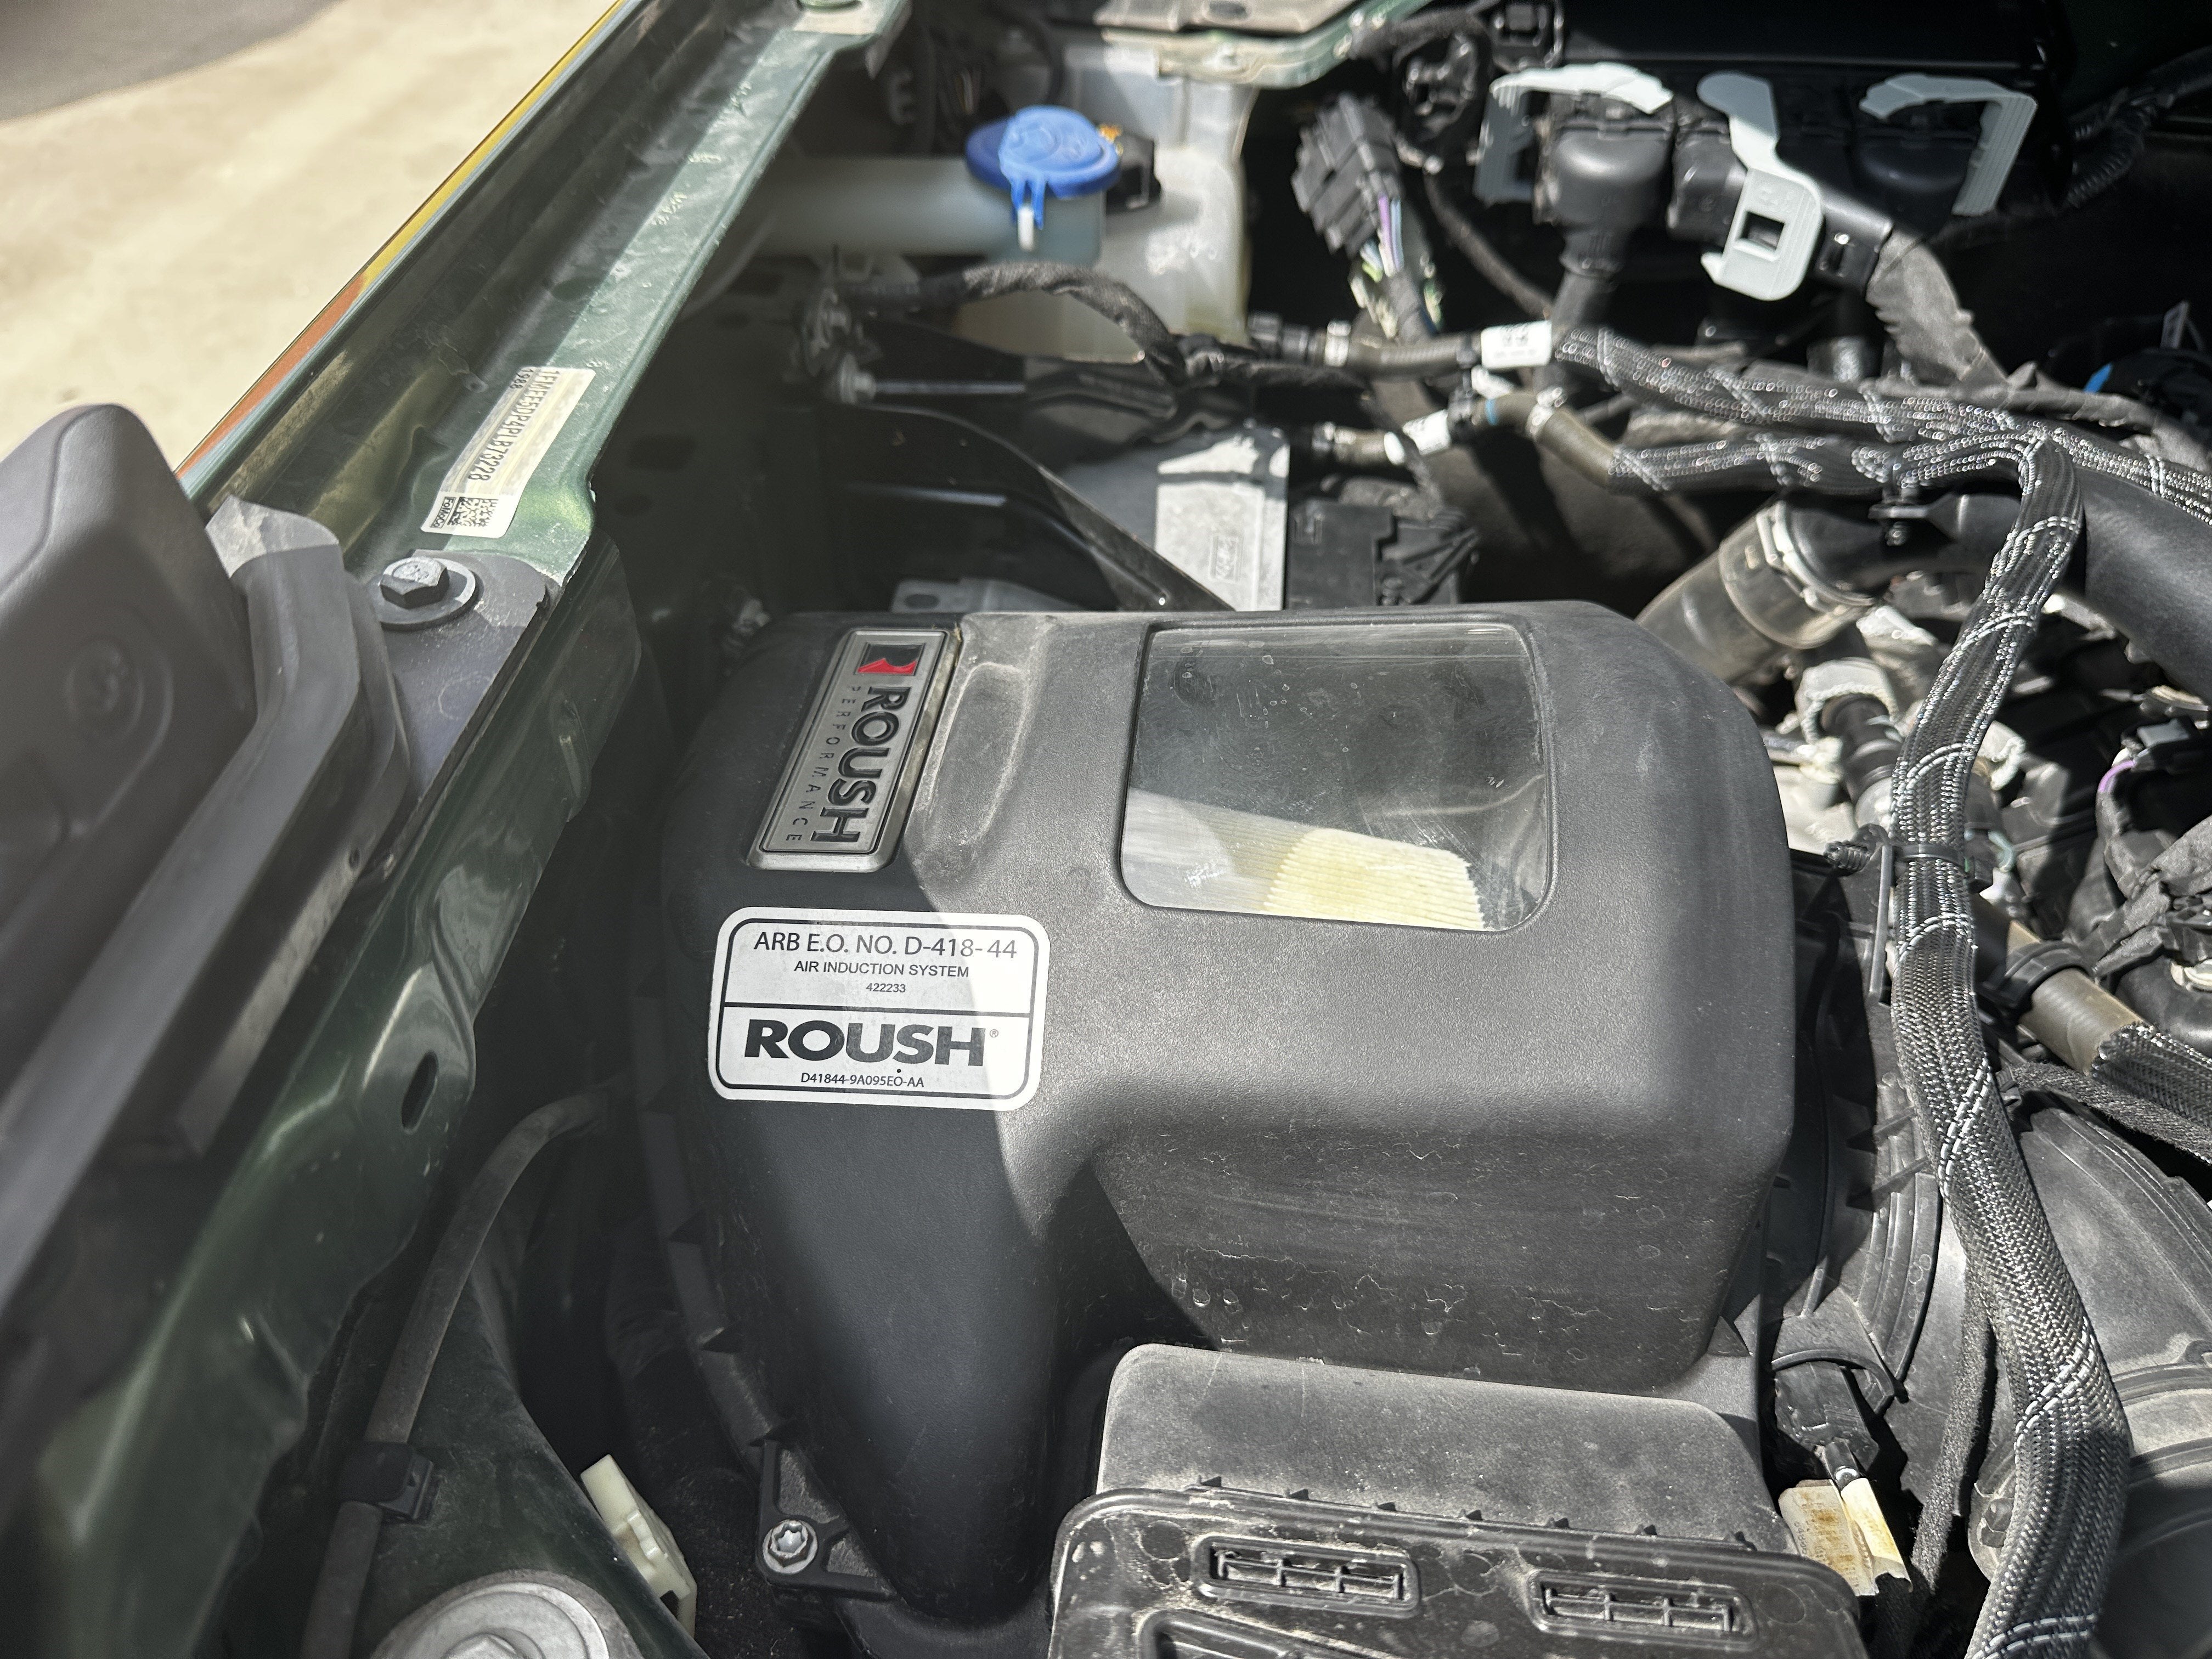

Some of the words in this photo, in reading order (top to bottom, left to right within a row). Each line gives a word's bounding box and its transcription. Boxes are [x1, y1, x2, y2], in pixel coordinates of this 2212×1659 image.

[433, 497, 454, 527] FoMoCo
[786, 685, 861, 842] PERFORMANCE
[810, 686, 911, 843] ROUSH
[753, 932, 800, 951] ARB
[807, 933, 849, 953] E.O.
[856, 935, 897, 955] NO.
[794, 961, 819, 973] AIR
[823, 961, 905, 975] INDUCTION
[908, 964, 969, 978] SYSTEM
[866, 983, 906, 993] 422233
